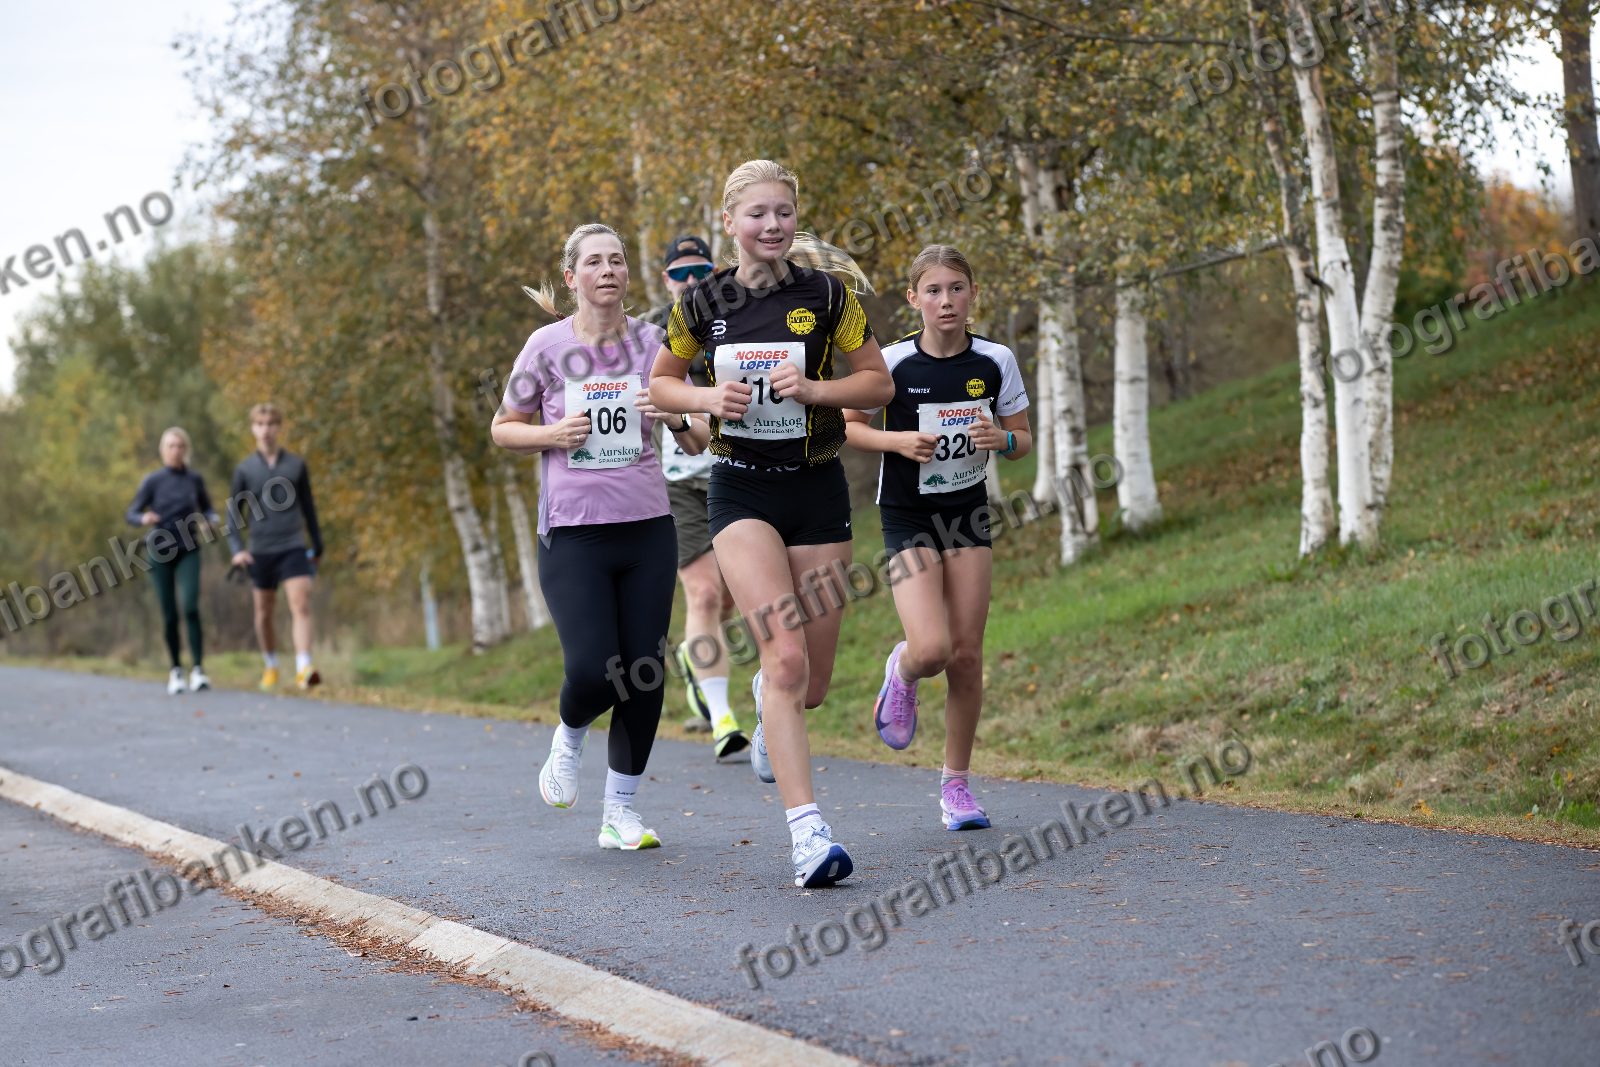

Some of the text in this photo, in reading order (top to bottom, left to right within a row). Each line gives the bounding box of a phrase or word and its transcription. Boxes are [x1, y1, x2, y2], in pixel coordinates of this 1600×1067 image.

[734, 350, 789, 360] NORGES
[740, 360, 780, 370] LØPET
[582, 382, 628, 391] NORGES
[586, 391, 621, 400] LØPET
[753, 417, 803, 428] Aurskog
[941, 416, 977, 426] LØPET
[599, 446, 640, 457] Aurskog
